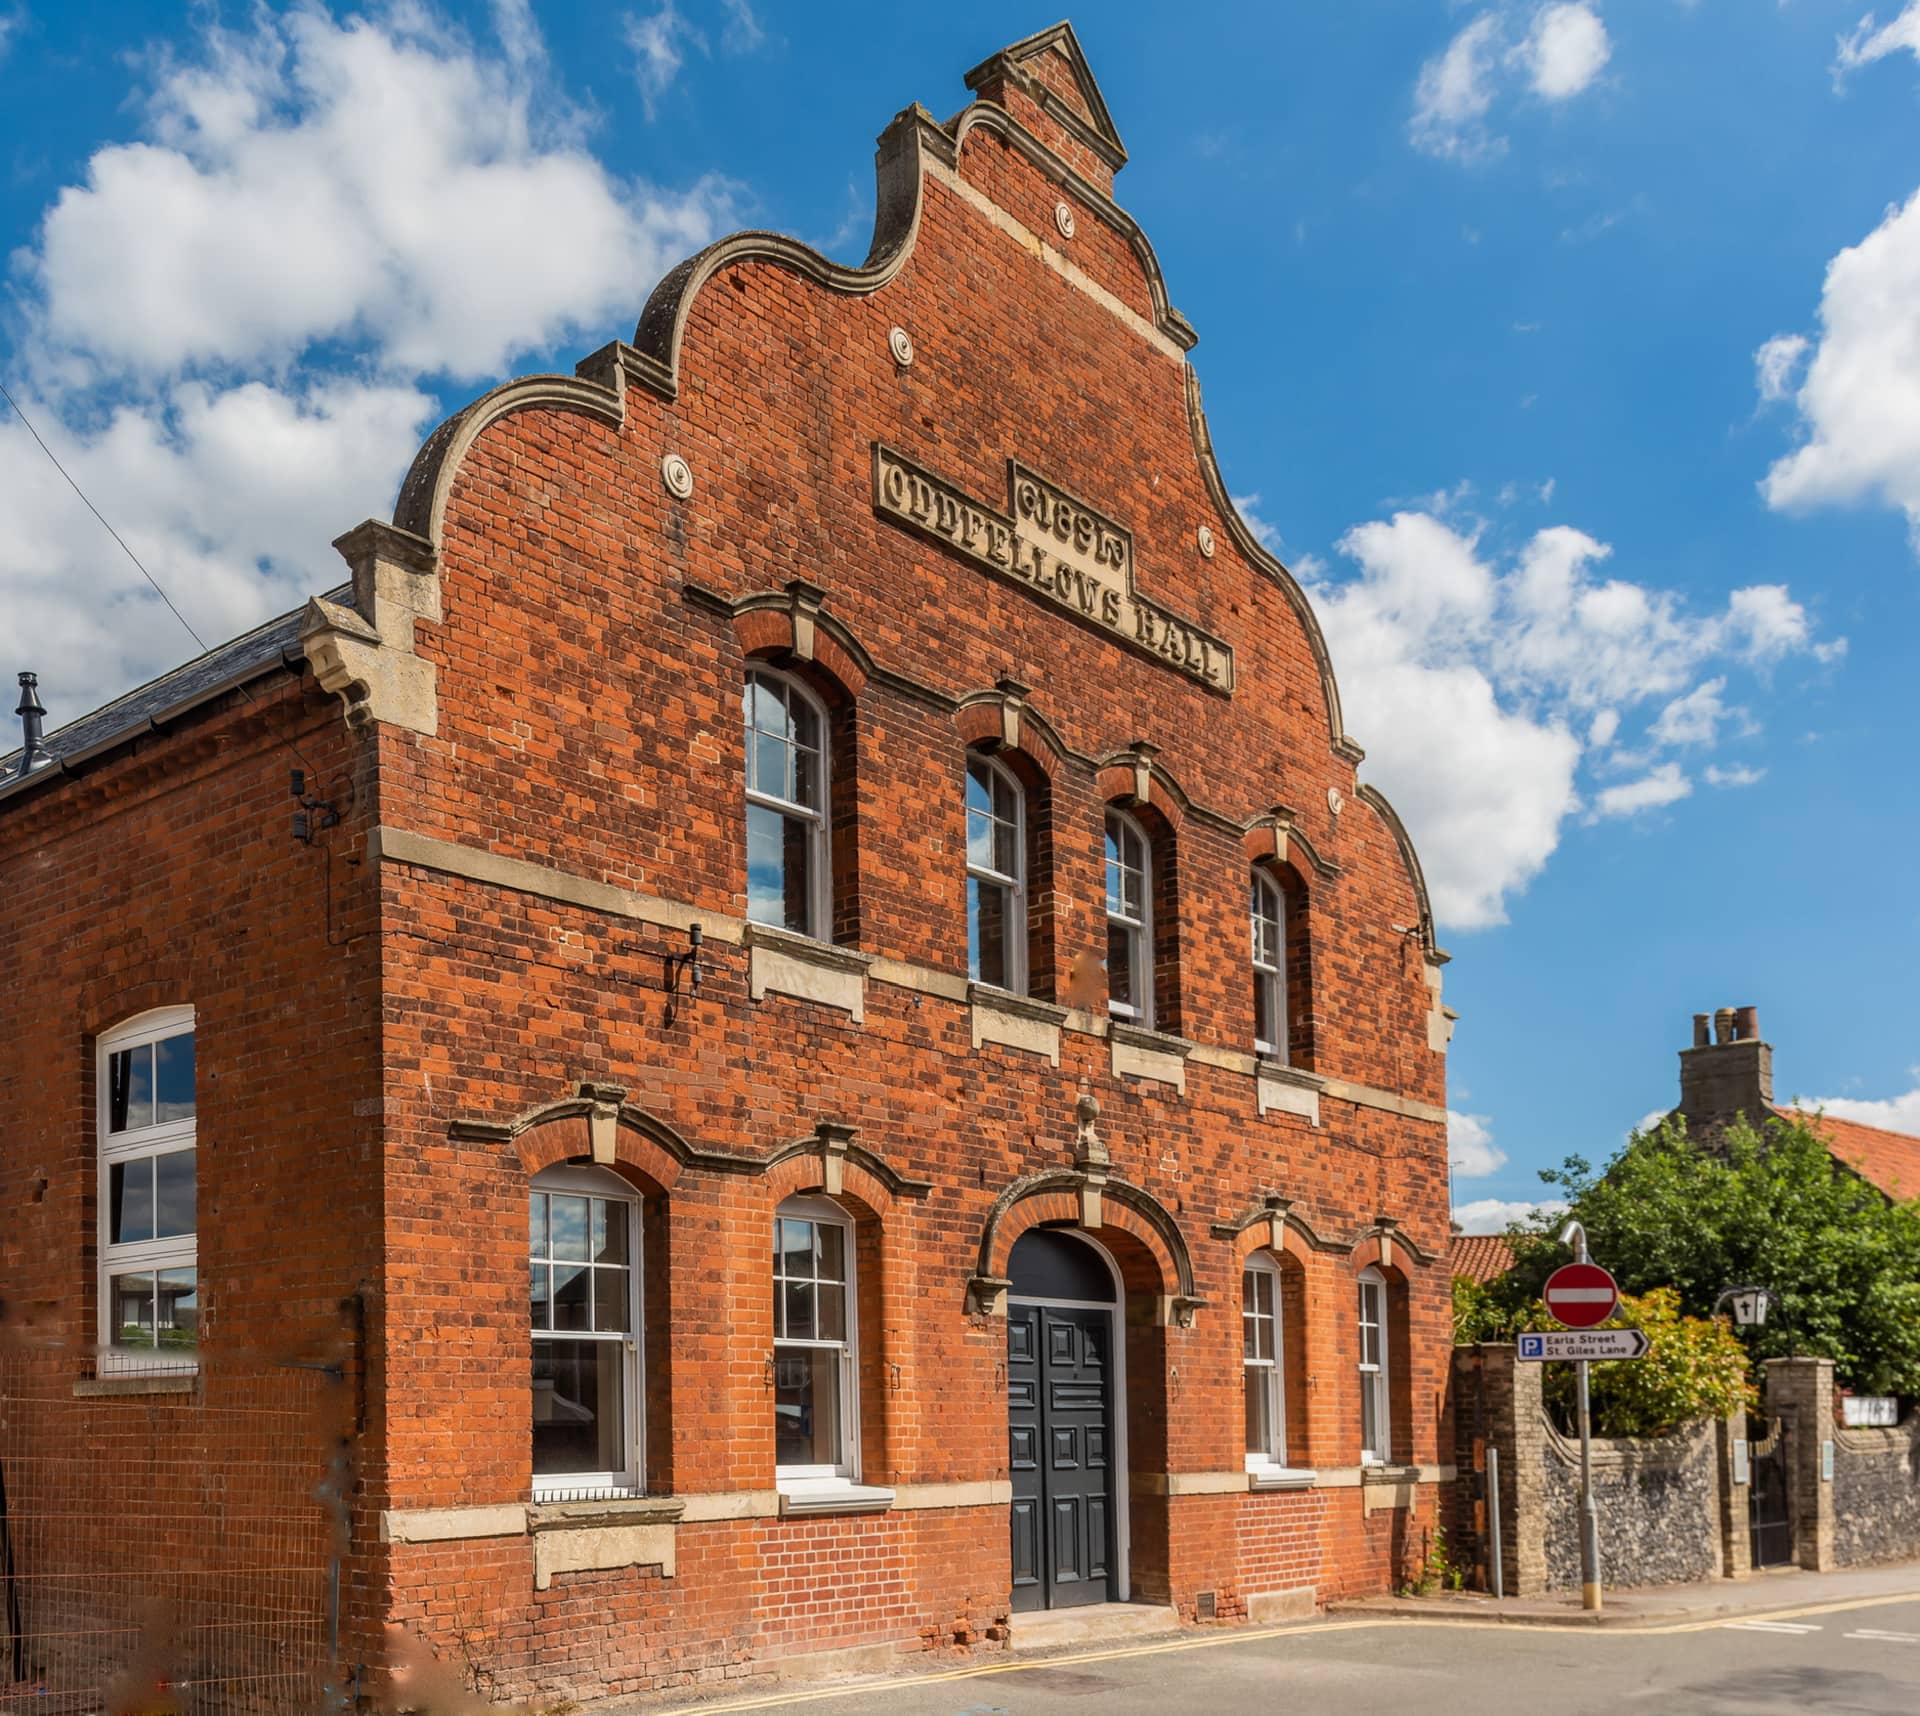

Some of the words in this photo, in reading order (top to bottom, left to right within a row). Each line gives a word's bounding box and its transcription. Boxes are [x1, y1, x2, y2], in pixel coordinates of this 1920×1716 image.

[884, 464, 1121, 627] ODDFELLOWS
[1133, 603, 1219, 682] HALL
[1546, 1336, 1575, 1345] Earls
[1580, 1335, 1616, 1344] Street
[1525, 1340, 1538, 1355] P
[1546, 1347, 1563, 1356] St.
[1567, 1346, 1595, 1356] Giles
[1599, 1345, 1627, 1355] Lane
